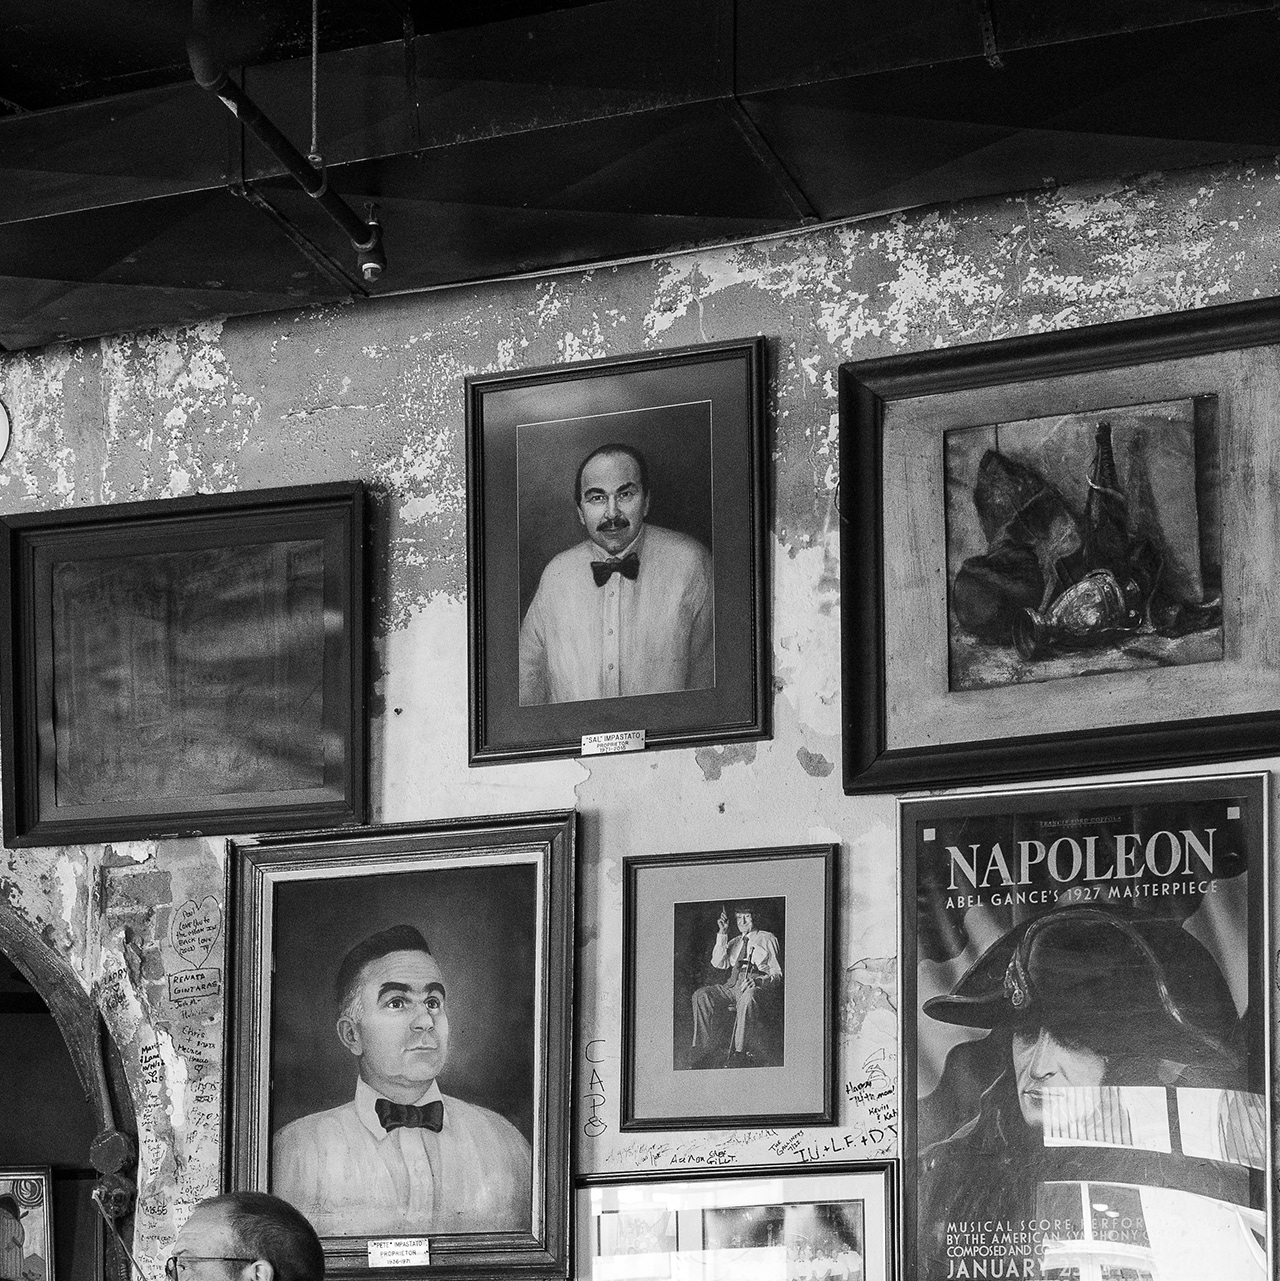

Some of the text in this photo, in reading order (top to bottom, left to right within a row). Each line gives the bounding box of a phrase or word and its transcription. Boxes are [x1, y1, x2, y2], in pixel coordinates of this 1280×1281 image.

[604, 732, 641, 741] IMPASTATO
[945, 828, 1217, 889] NAPOLEON
[945, 880, 1218, 909] ABEL GANCE'S 1927 MASTERPIECE
[947, 1221, 1012, 1233] MUSICAL
[1021, 1219, 1071, 1231] SCORE
[947, 1234, 959, 1245] BY
[964, 1234, 986, 1244] THE
[991, 1232, 1060, 1243] AMERICAN
[947, 1246, 1007, 1257] COMPOSED
[1009, 1245, 1031, 1256] AND
[947, 1258, 1048, 1279] JANUARY
